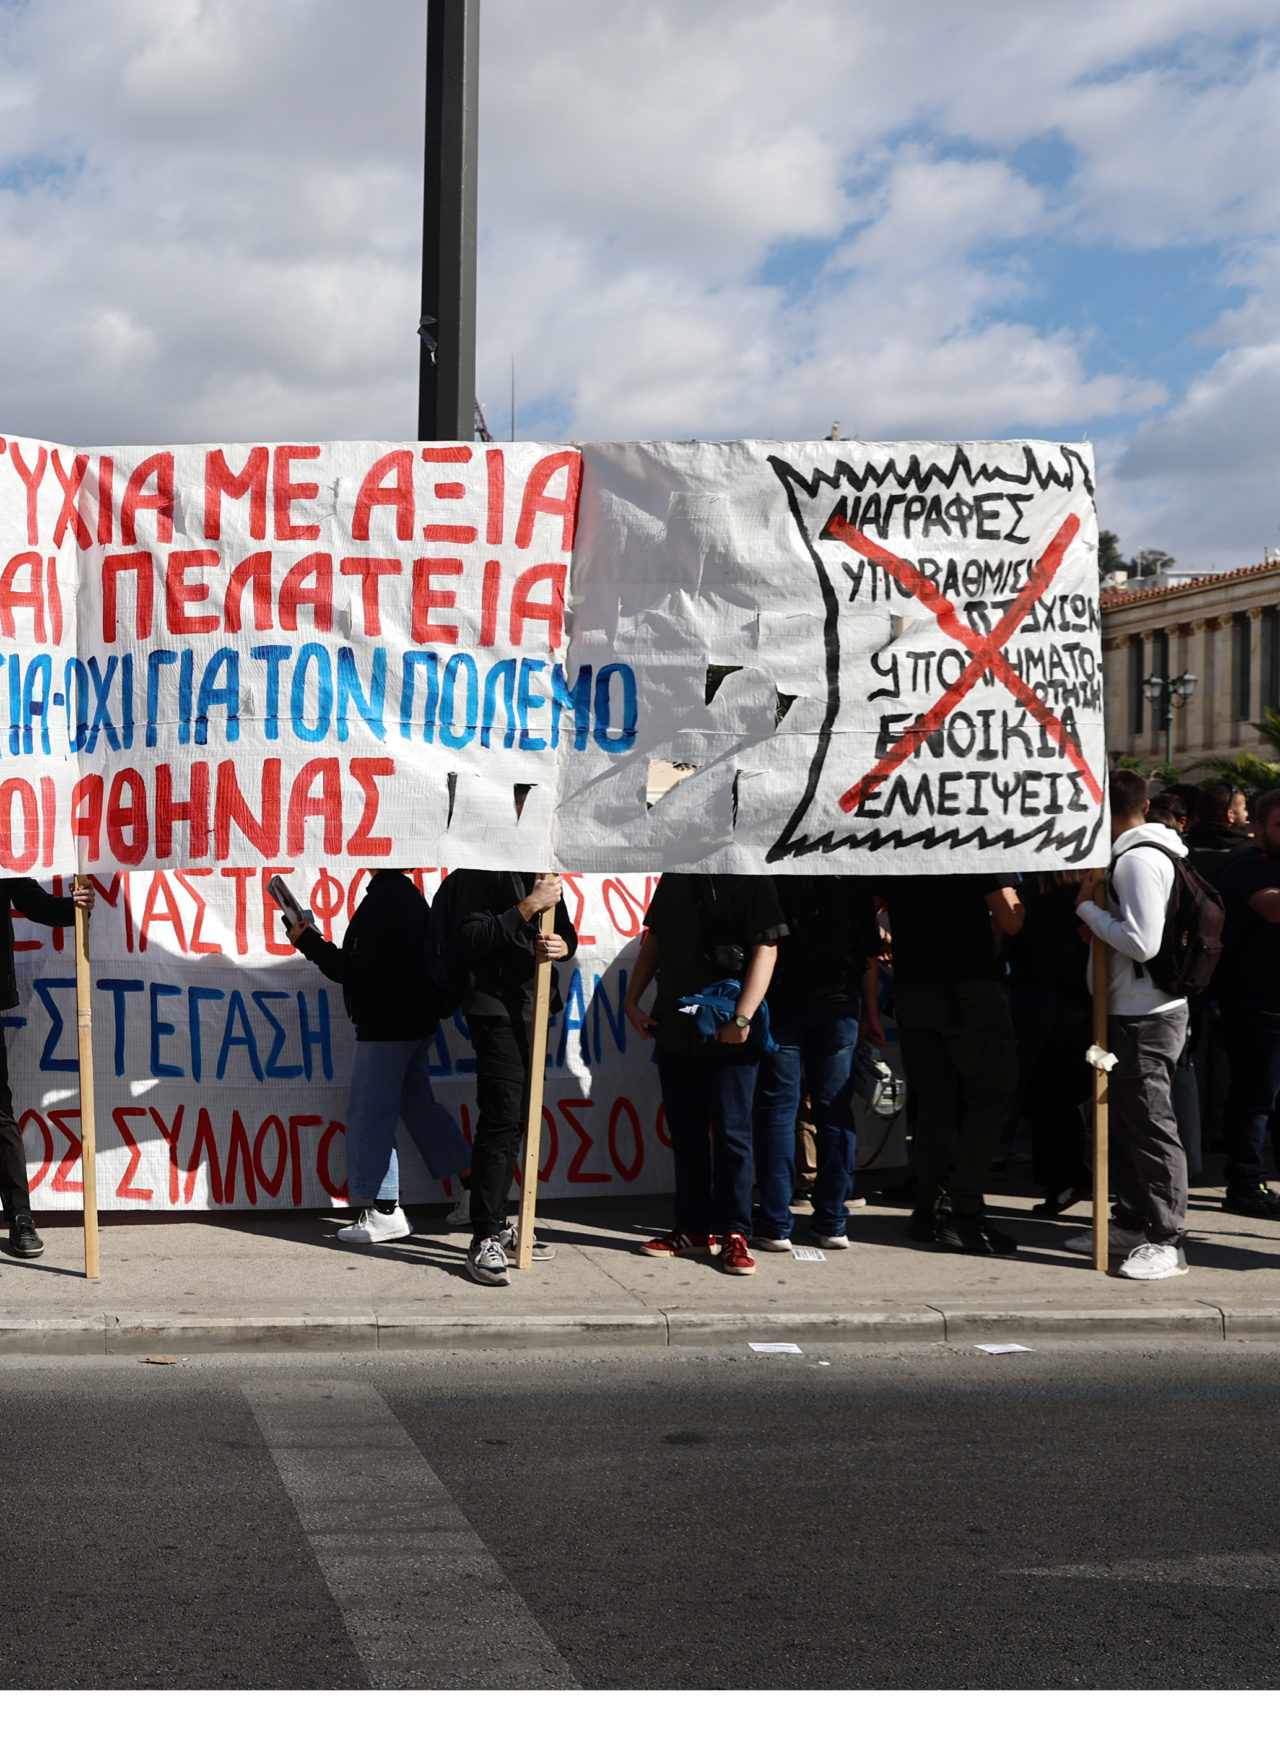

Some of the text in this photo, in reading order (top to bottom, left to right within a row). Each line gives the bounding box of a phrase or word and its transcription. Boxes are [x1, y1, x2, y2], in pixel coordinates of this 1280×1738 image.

[204, 446, 321, 541] ΜΕ
[351, 446, 582, 553] ΑΞΙΑ
[102, 550, 568, 651] ΠΕΛΑΤΕΙΑ
[250, 642, 388, 743] ΤΟΝ
[400, 650, 638, 753] ΠΟΛΕΜΟ
[71, 757, 395, 866] ΑΘΗΝΑΣ
